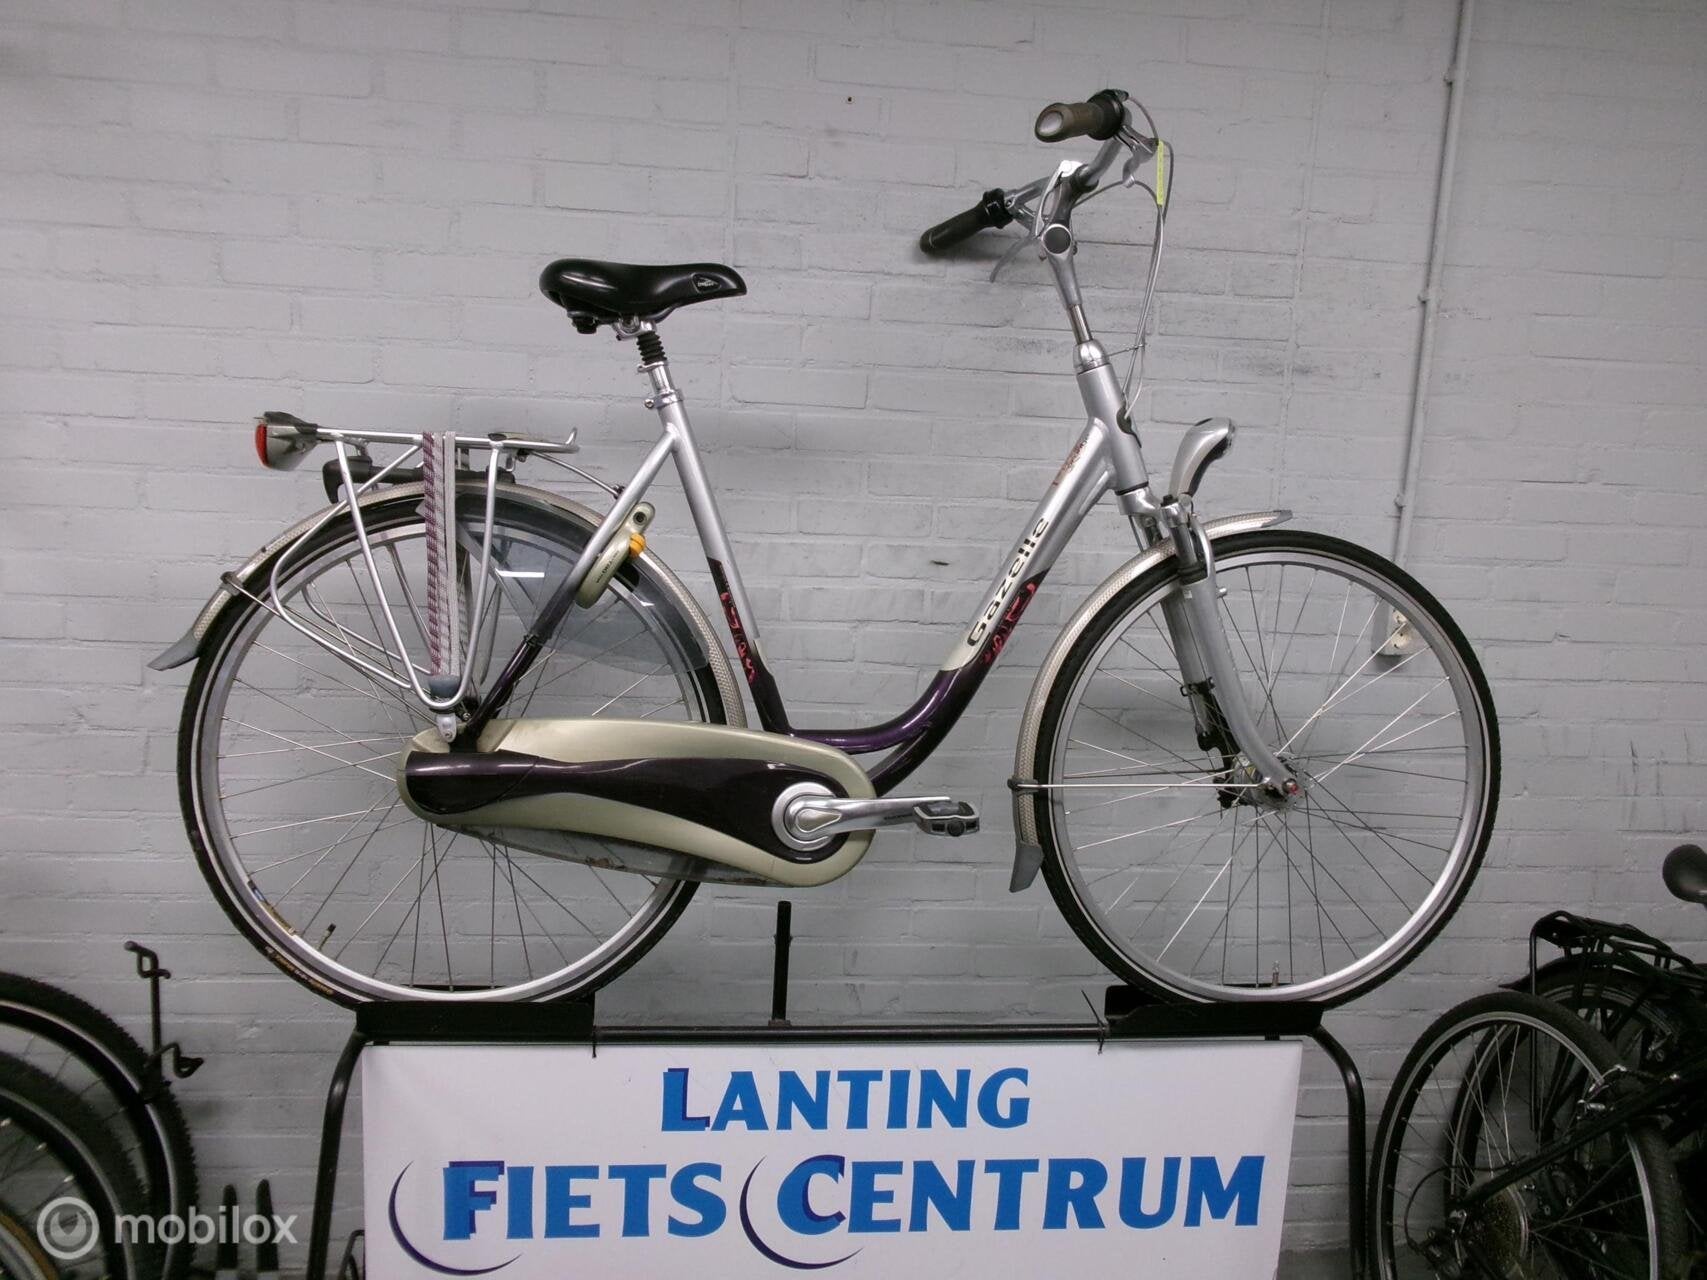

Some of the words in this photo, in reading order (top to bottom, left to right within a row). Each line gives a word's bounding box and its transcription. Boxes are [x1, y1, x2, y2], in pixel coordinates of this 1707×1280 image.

[967, 518, 1049, 646] Gazelle
[662, 1067, 1030, 1131] LANTING
[443, 1160, 726, 1240] FIETS
[777, 1154, 1265, 1235] CENTRUM
